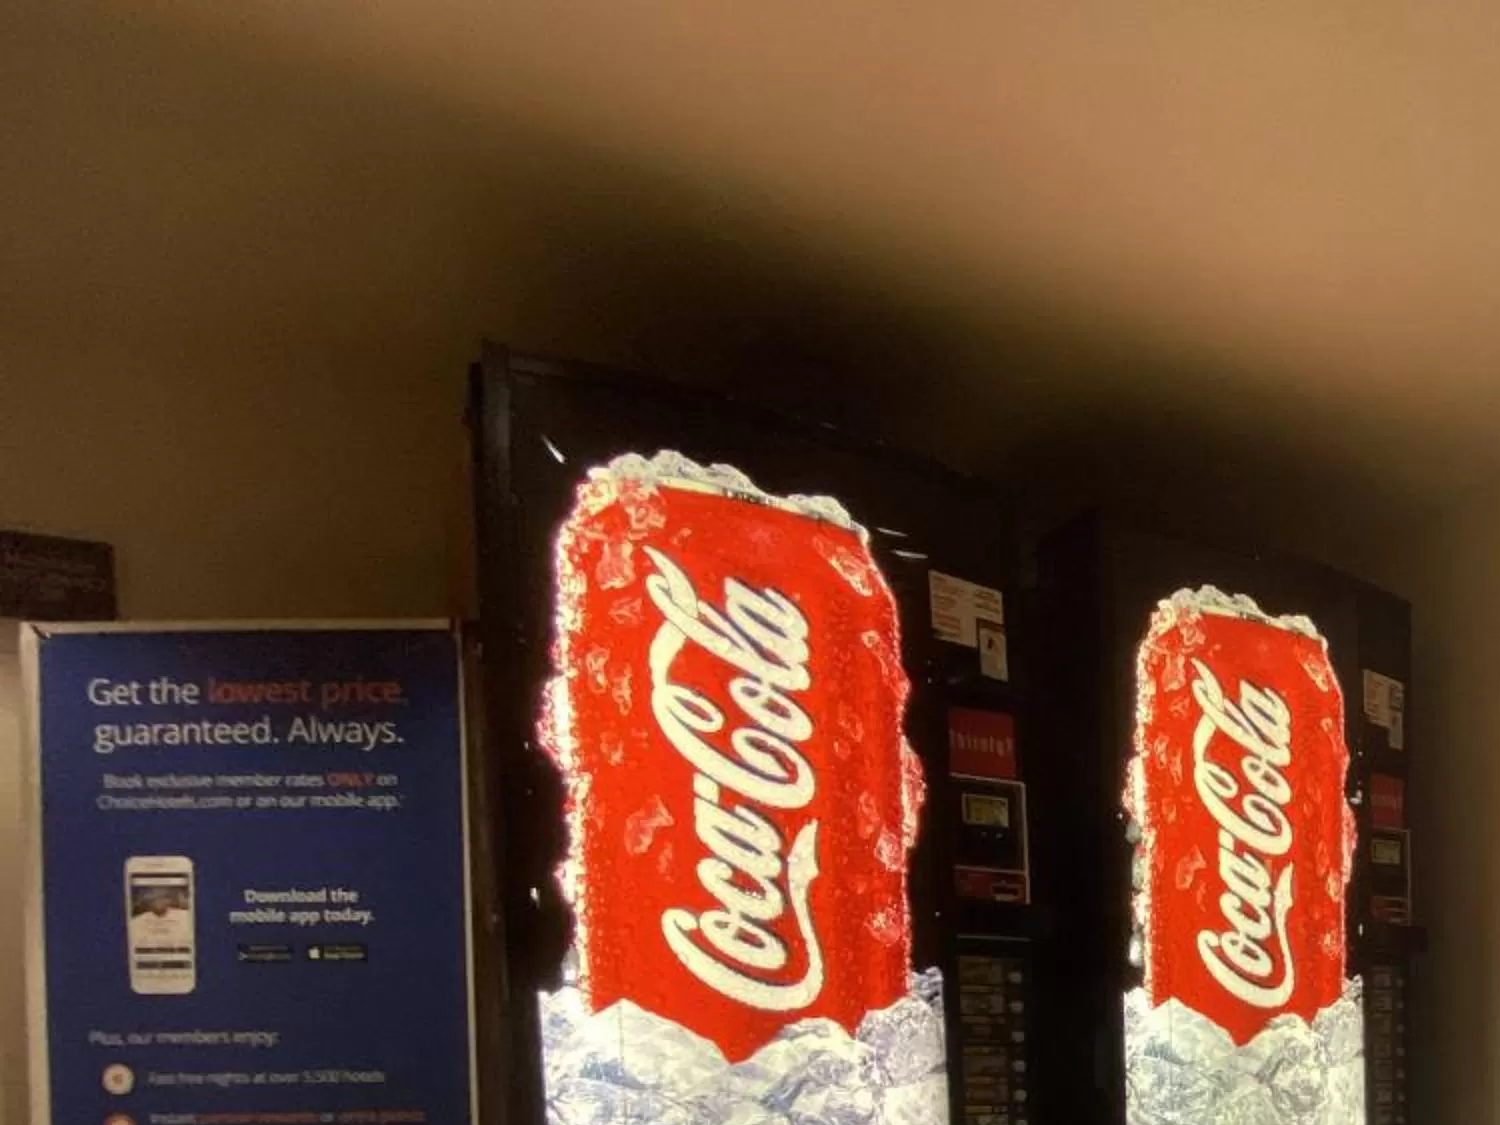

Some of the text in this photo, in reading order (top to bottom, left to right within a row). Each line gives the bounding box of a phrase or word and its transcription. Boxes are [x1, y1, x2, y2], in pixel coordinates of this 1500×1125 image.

[87, 677, 143, 706] Get
[149, 676, 201, 705] the
[207, 677, 313, 704] lowest
[92, 714, 405, 754] guaranteed. Always.
[642, 545, 824, 1011] Coca-Cola
[1192, 657, 1294, 1008] Coca-Cola
